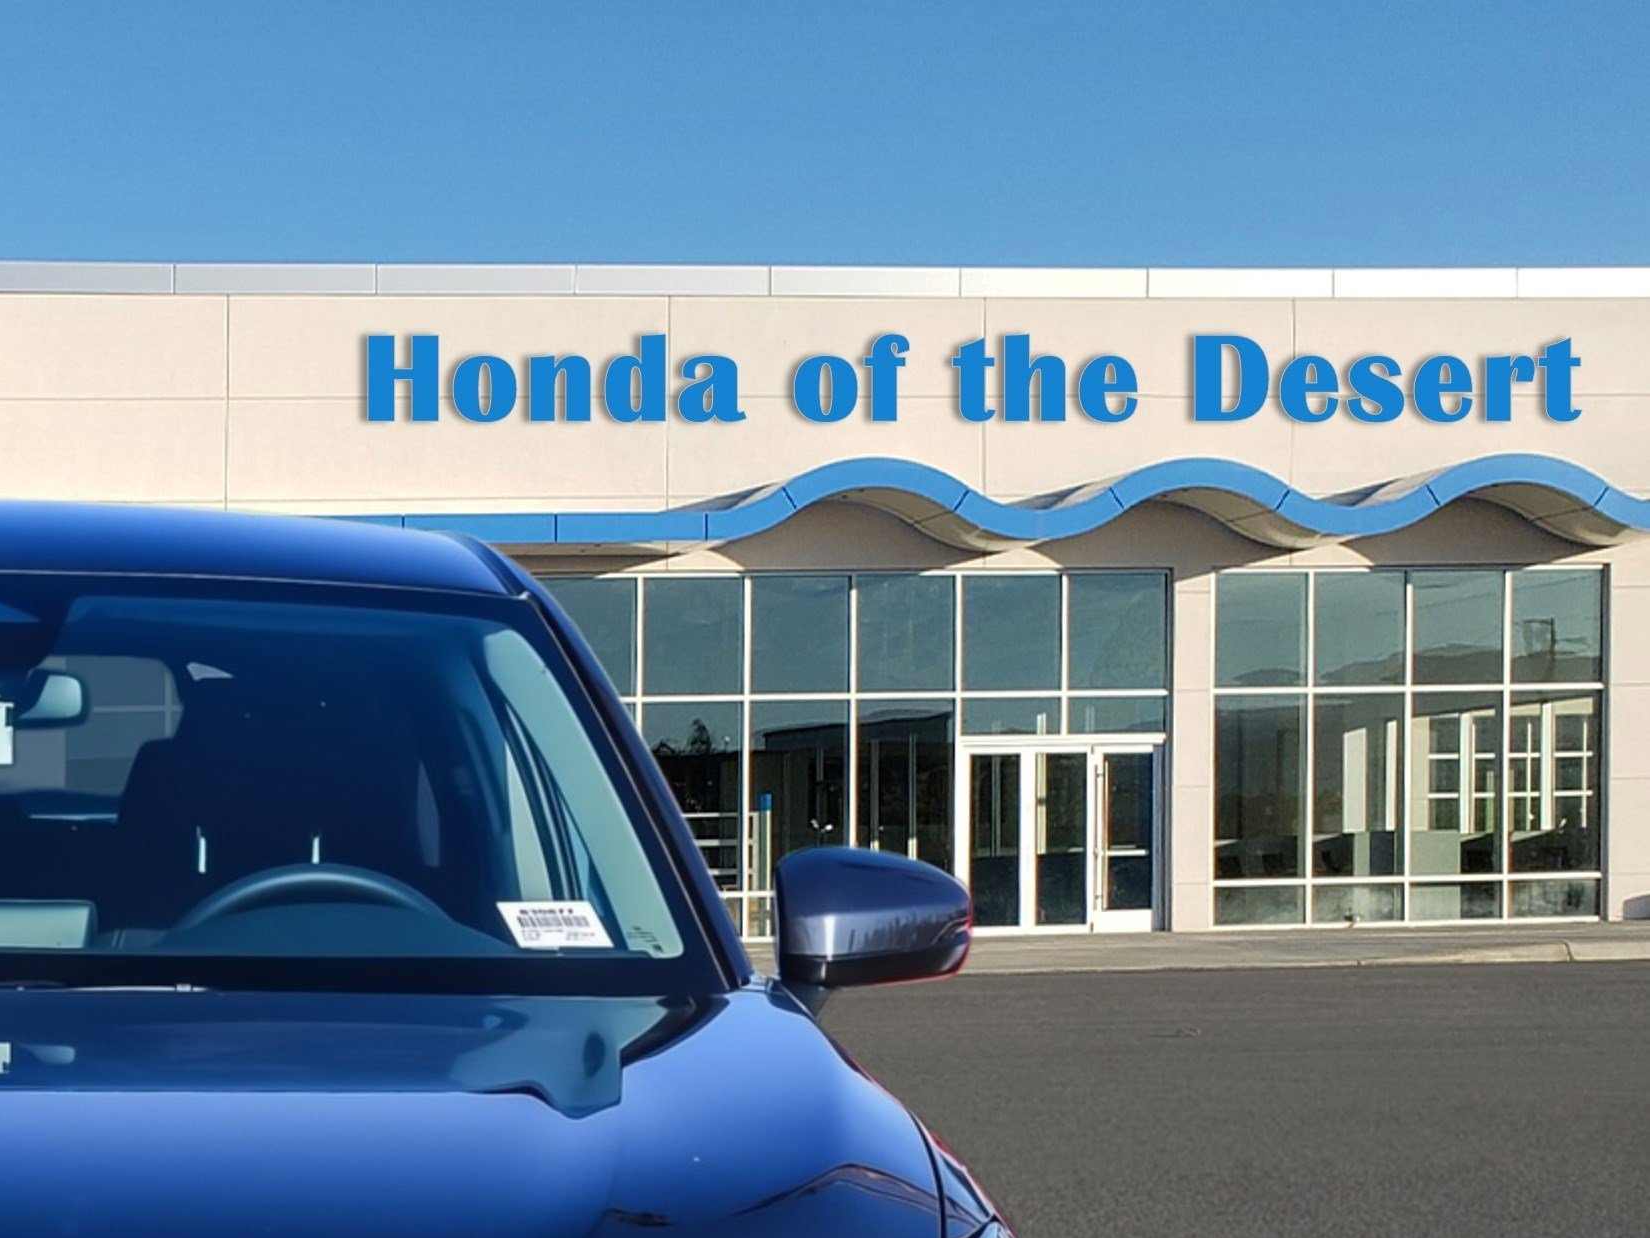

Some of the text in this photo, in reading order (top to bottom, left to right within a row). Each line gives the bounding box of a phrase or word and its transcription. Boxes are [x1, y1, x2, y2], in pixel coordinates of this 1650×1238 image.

[365, 333, 1583, 423] Honda of the Desert
